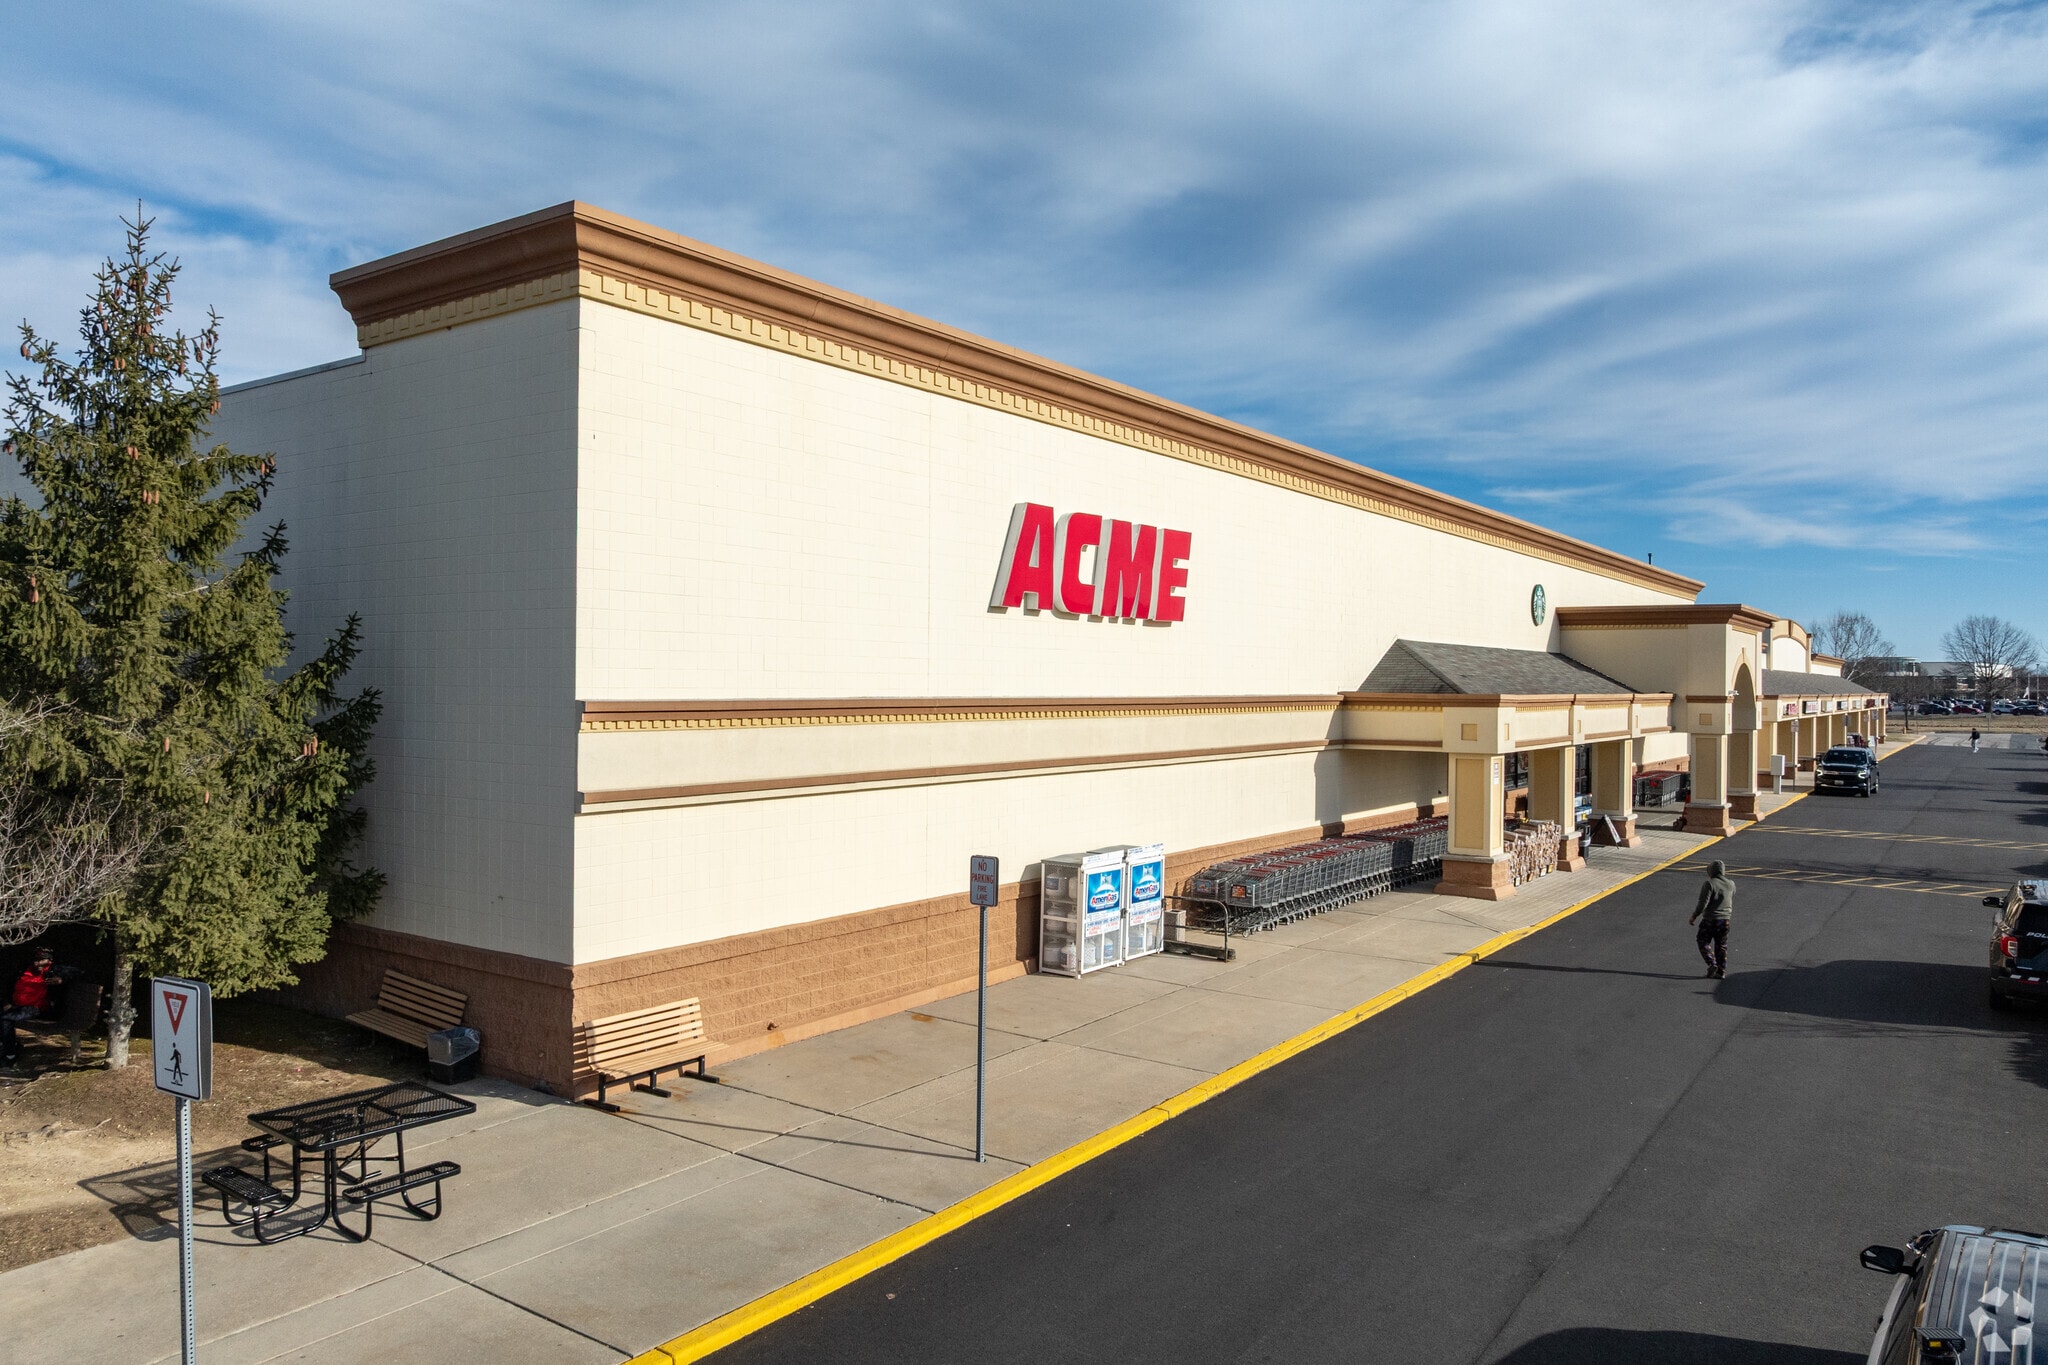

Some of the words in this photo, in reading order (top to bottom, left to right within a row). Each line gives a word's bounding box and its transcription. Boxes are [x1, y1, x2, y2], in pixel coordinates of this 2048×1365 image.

[1000, 502, 1192, 622] ACME
[978, 861, 987, 872] NO
[972, 874, 994, 884] PARKING
[1091, 893, 1117, 906] AmeriGas
[2026, 931, 2048, 939] POL
